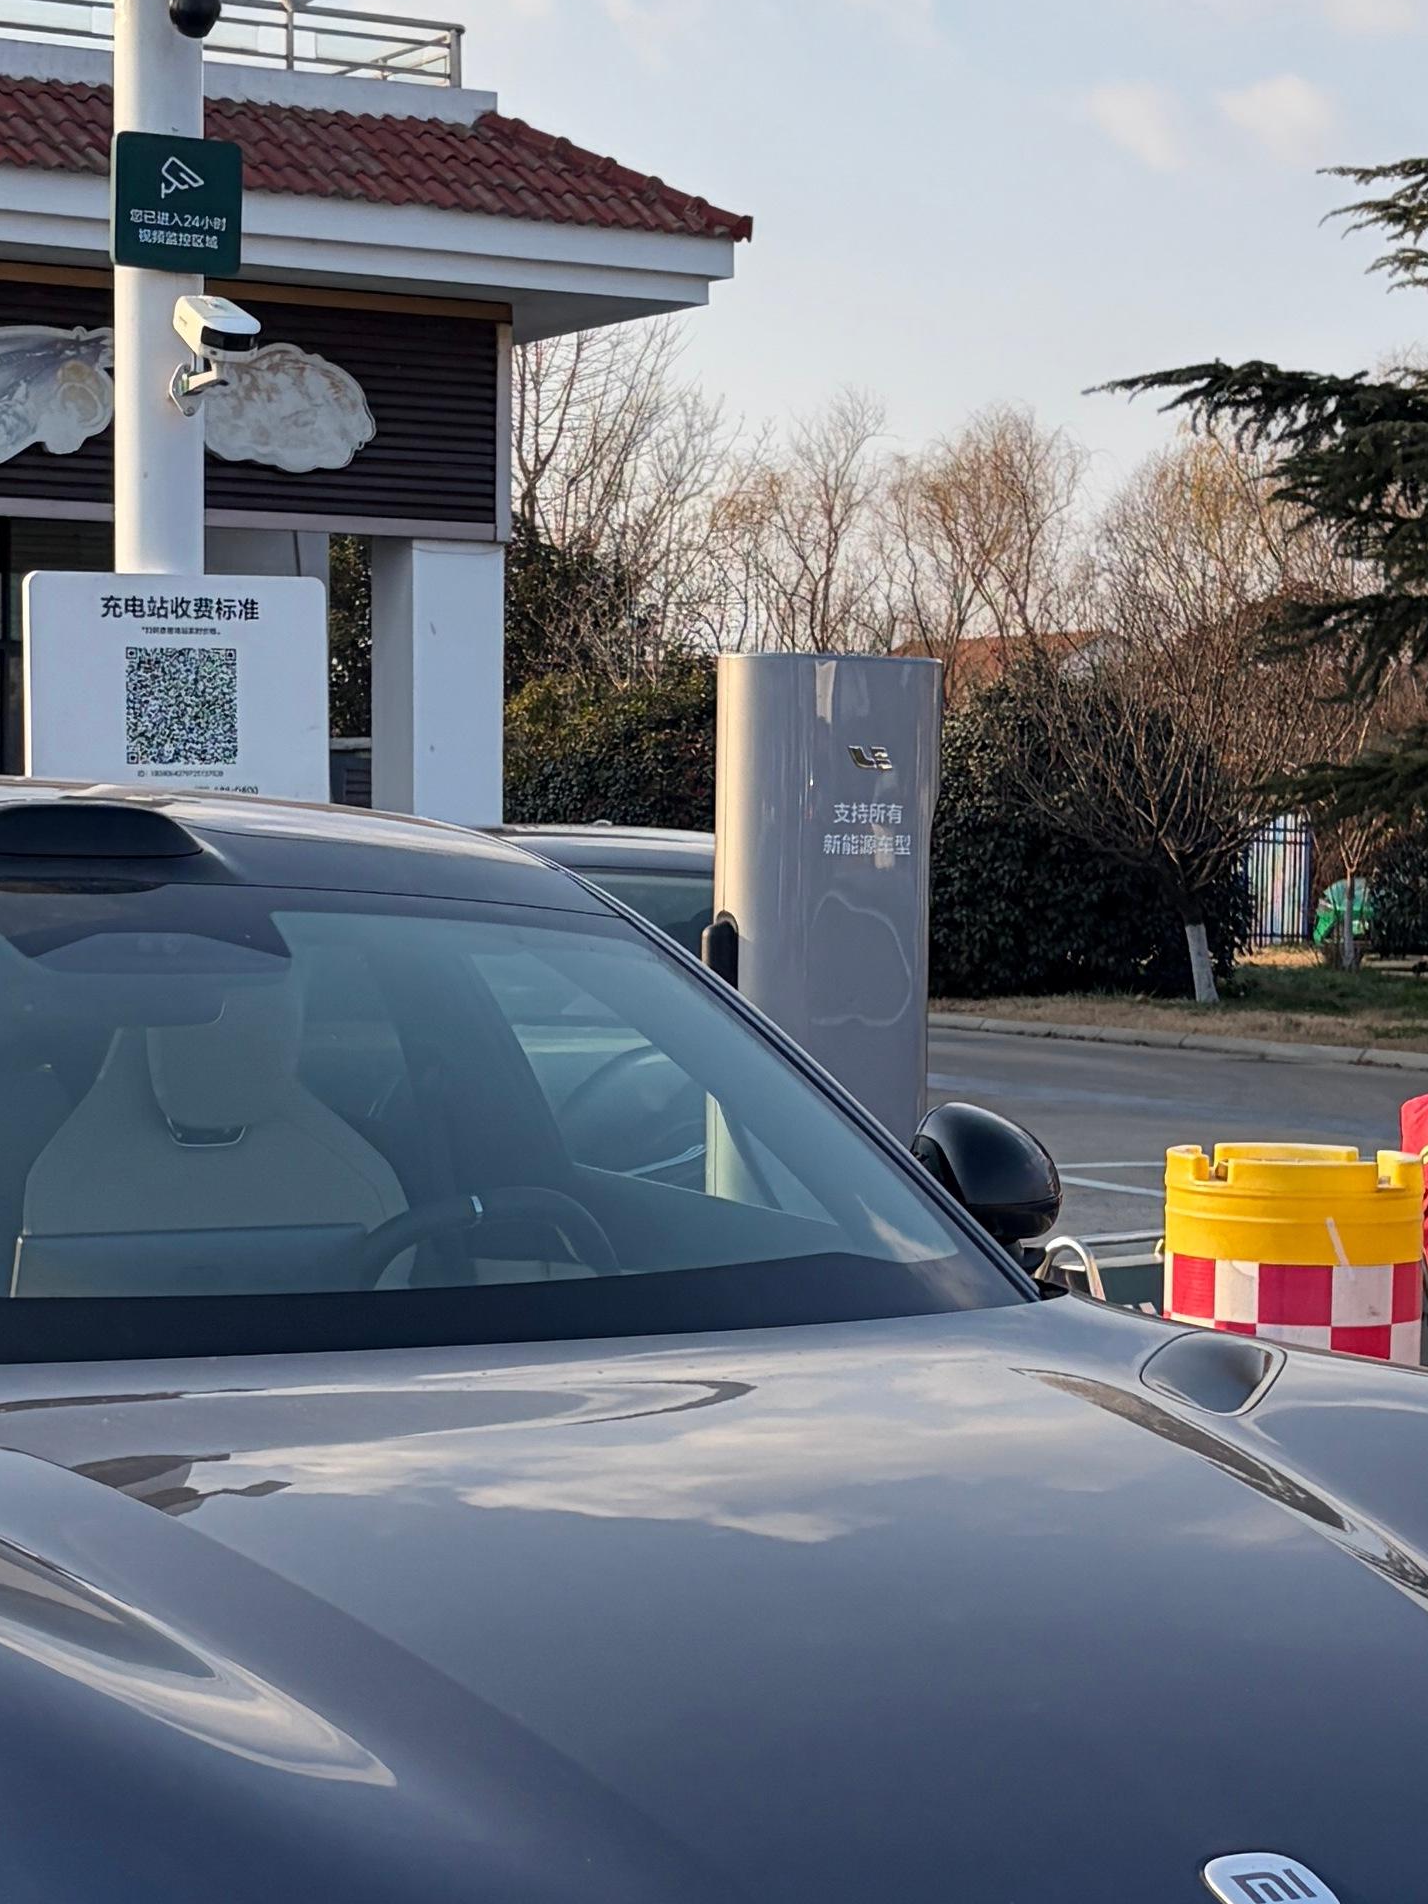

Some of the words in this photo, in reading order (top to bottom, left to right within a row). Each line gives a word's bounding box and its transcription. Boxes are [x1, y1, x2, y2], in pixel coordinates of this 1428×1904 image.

[129, 208, 227, 232] 您已进入24小时
[138, 228, 219, 249] 视频监控区域
[100, 595, 260, 621] 充电站收费标准
[833, 803, 903, 824] 支持所有
[823, 834, 911, 856] 新能源车型
